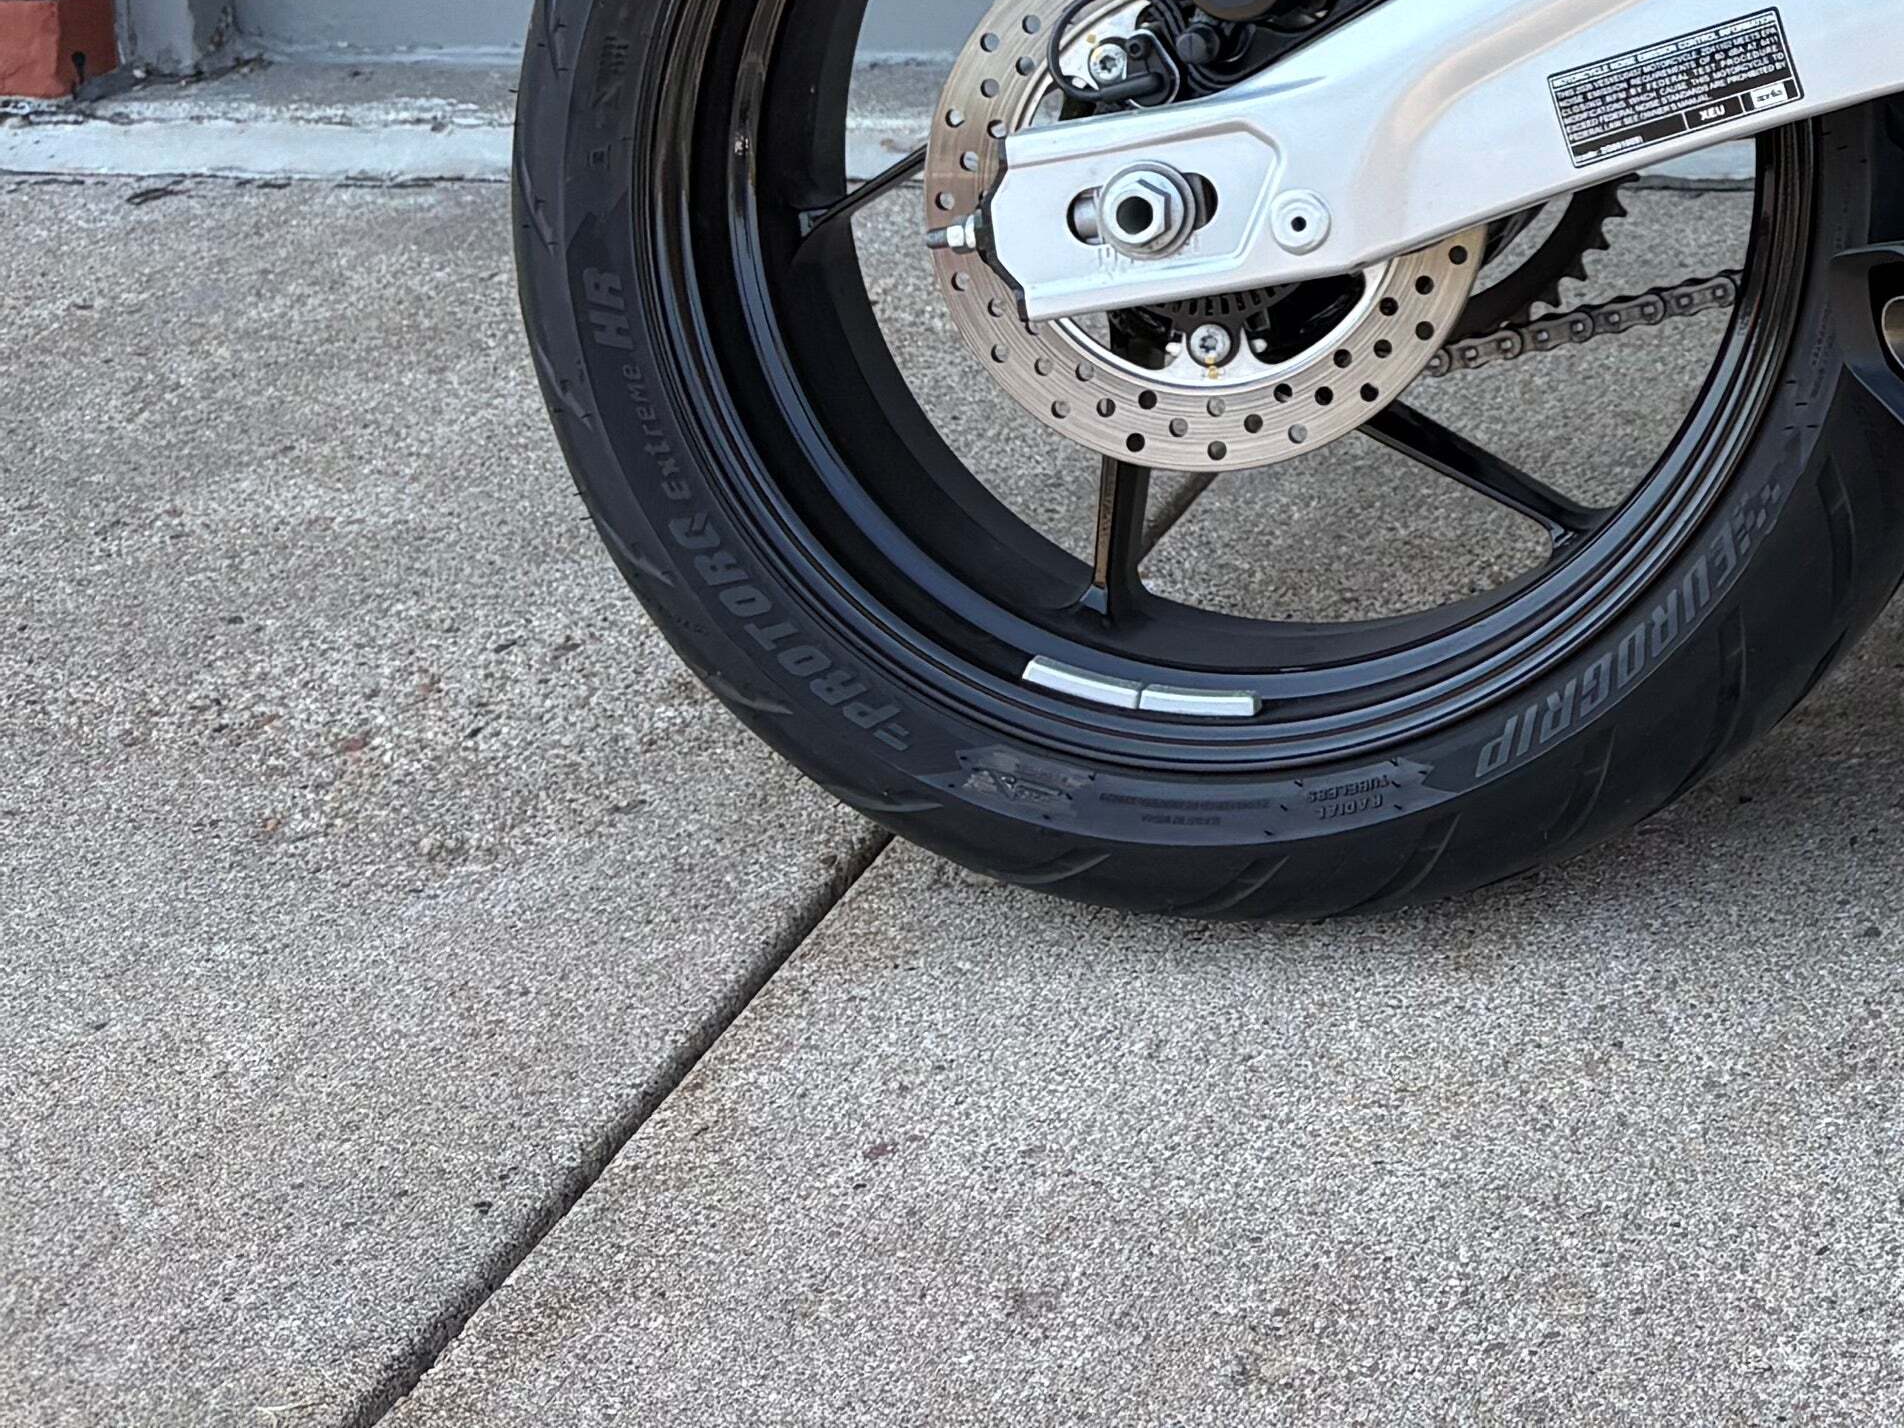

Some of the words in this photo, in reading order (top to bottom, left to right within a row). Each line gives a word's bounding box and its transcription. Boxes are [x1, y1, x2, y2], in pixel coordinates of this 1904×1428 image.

[1698, 104, 1726, 121] XEU
[582, 266, 634, 351] HR
[668, 511, 900, 730] PROTORQ
[1475, 520, 1737, 778] EUROGRIP
